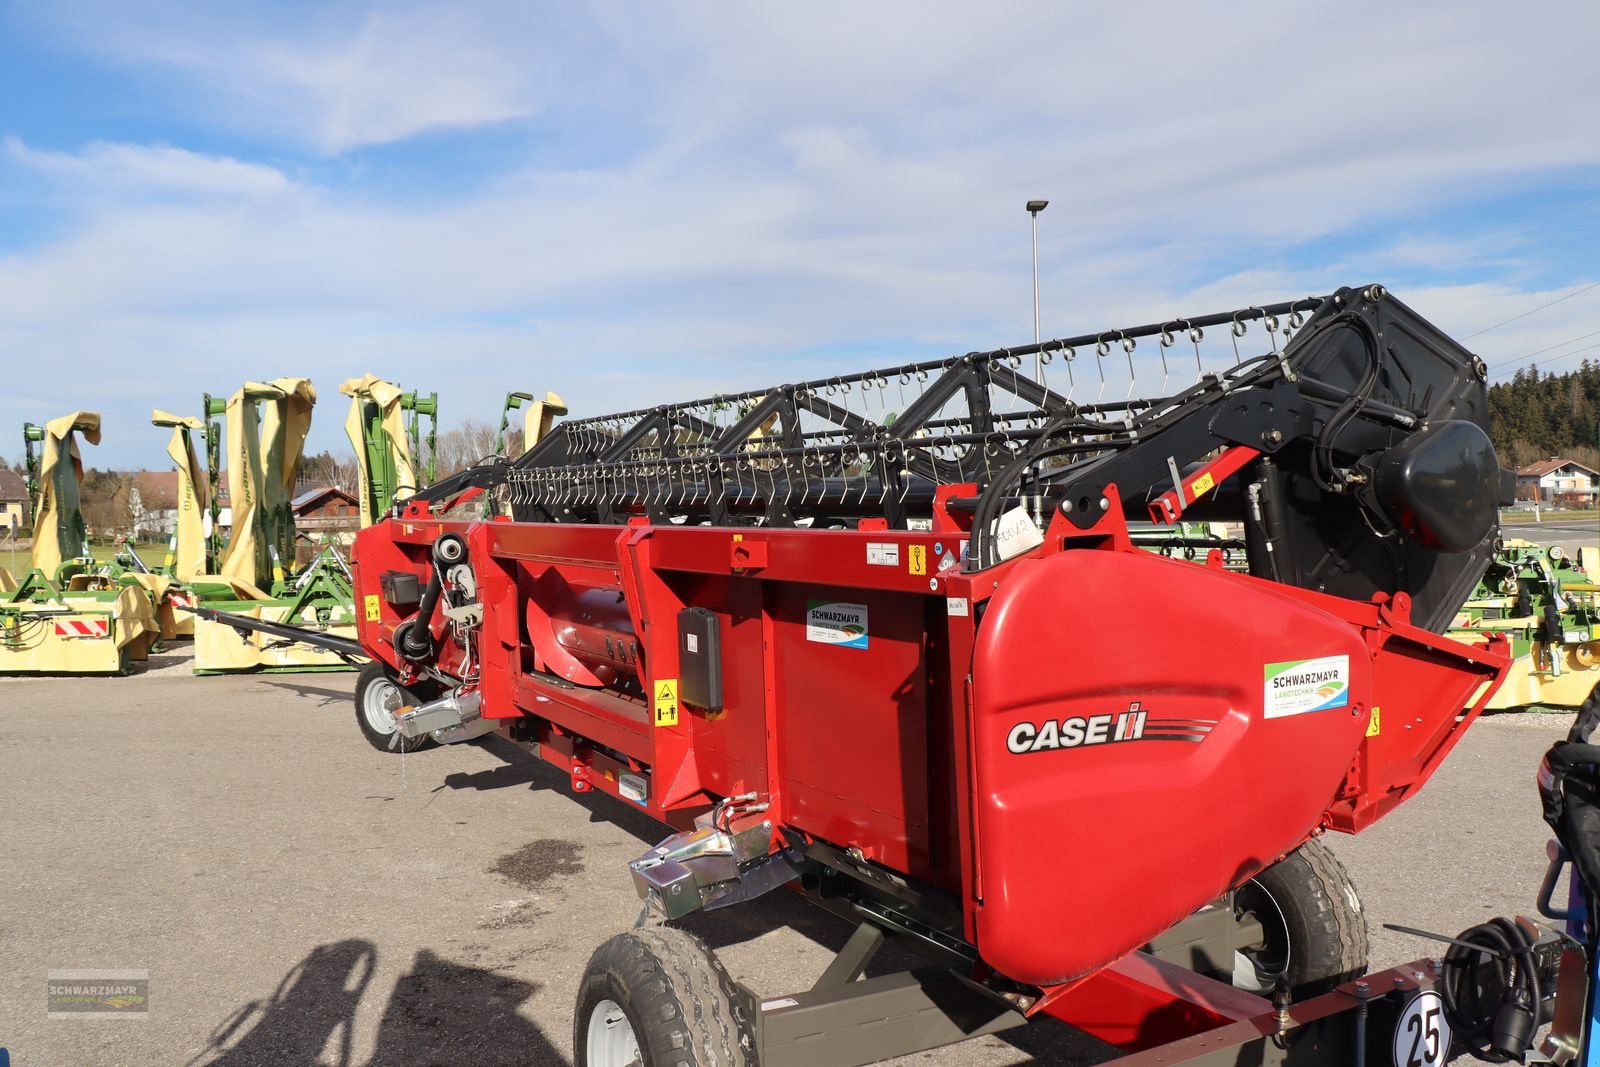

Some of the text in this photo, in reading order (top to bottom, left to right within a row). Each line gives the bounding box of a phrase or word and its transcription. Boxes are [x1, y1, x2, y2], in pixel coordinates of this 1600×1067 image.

[812, 610, 860, 624] SCHWARZMAYR
[1273, 669, 1339, 688] SCHWARZMAYR
[1274, 687, 1315, 699] LANDTECHNIK
[1007, 713, 1112, 754] CASE
[1407, 1007, 1440, 1067] 25
